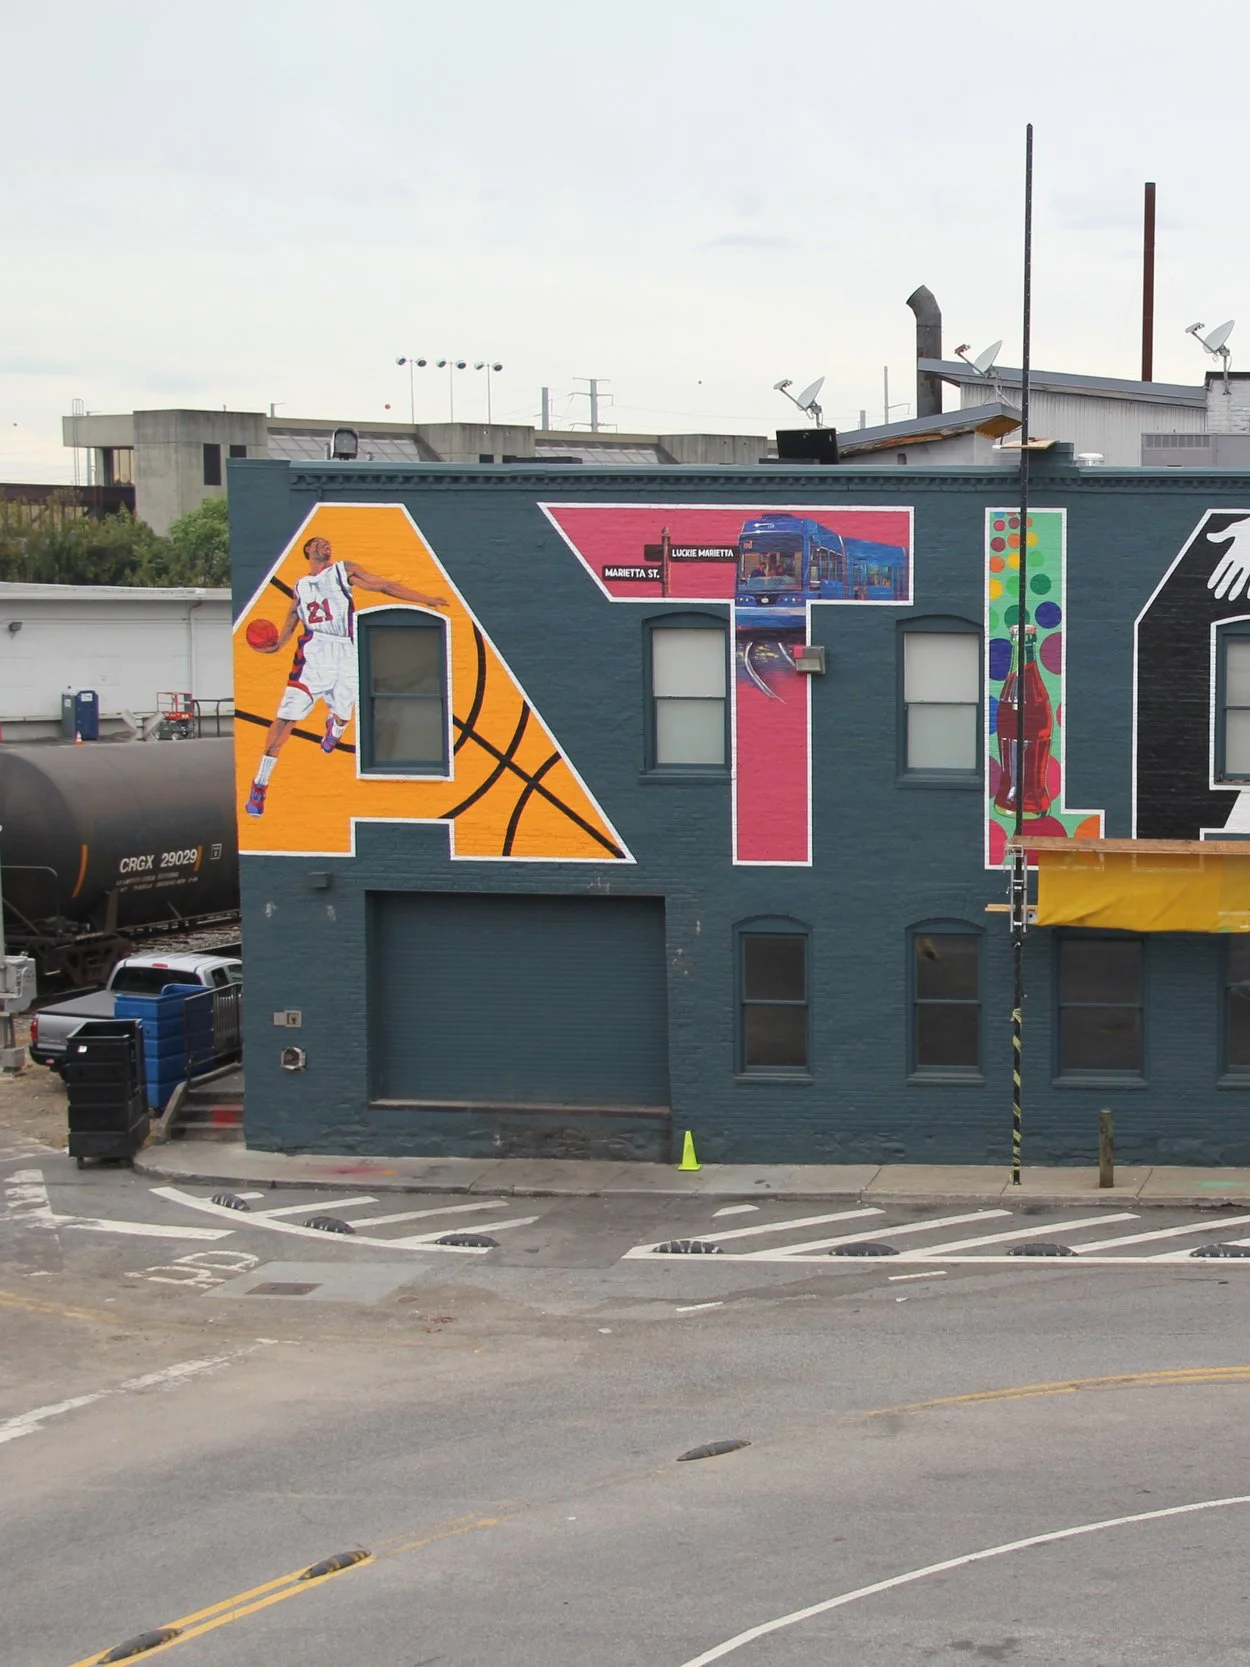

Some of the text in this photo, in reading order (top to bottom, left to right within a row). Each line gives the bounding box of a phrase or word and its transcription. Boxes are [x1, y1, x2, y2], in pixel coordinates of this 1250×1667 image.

[672, 548, 734, 559] LUCKIE MARIETTA
[604, 567, 660, 580] MARIETTA ST.
[306, 598, 334, 624] 21
[119, 848, 198, 873] CRGX 29029
